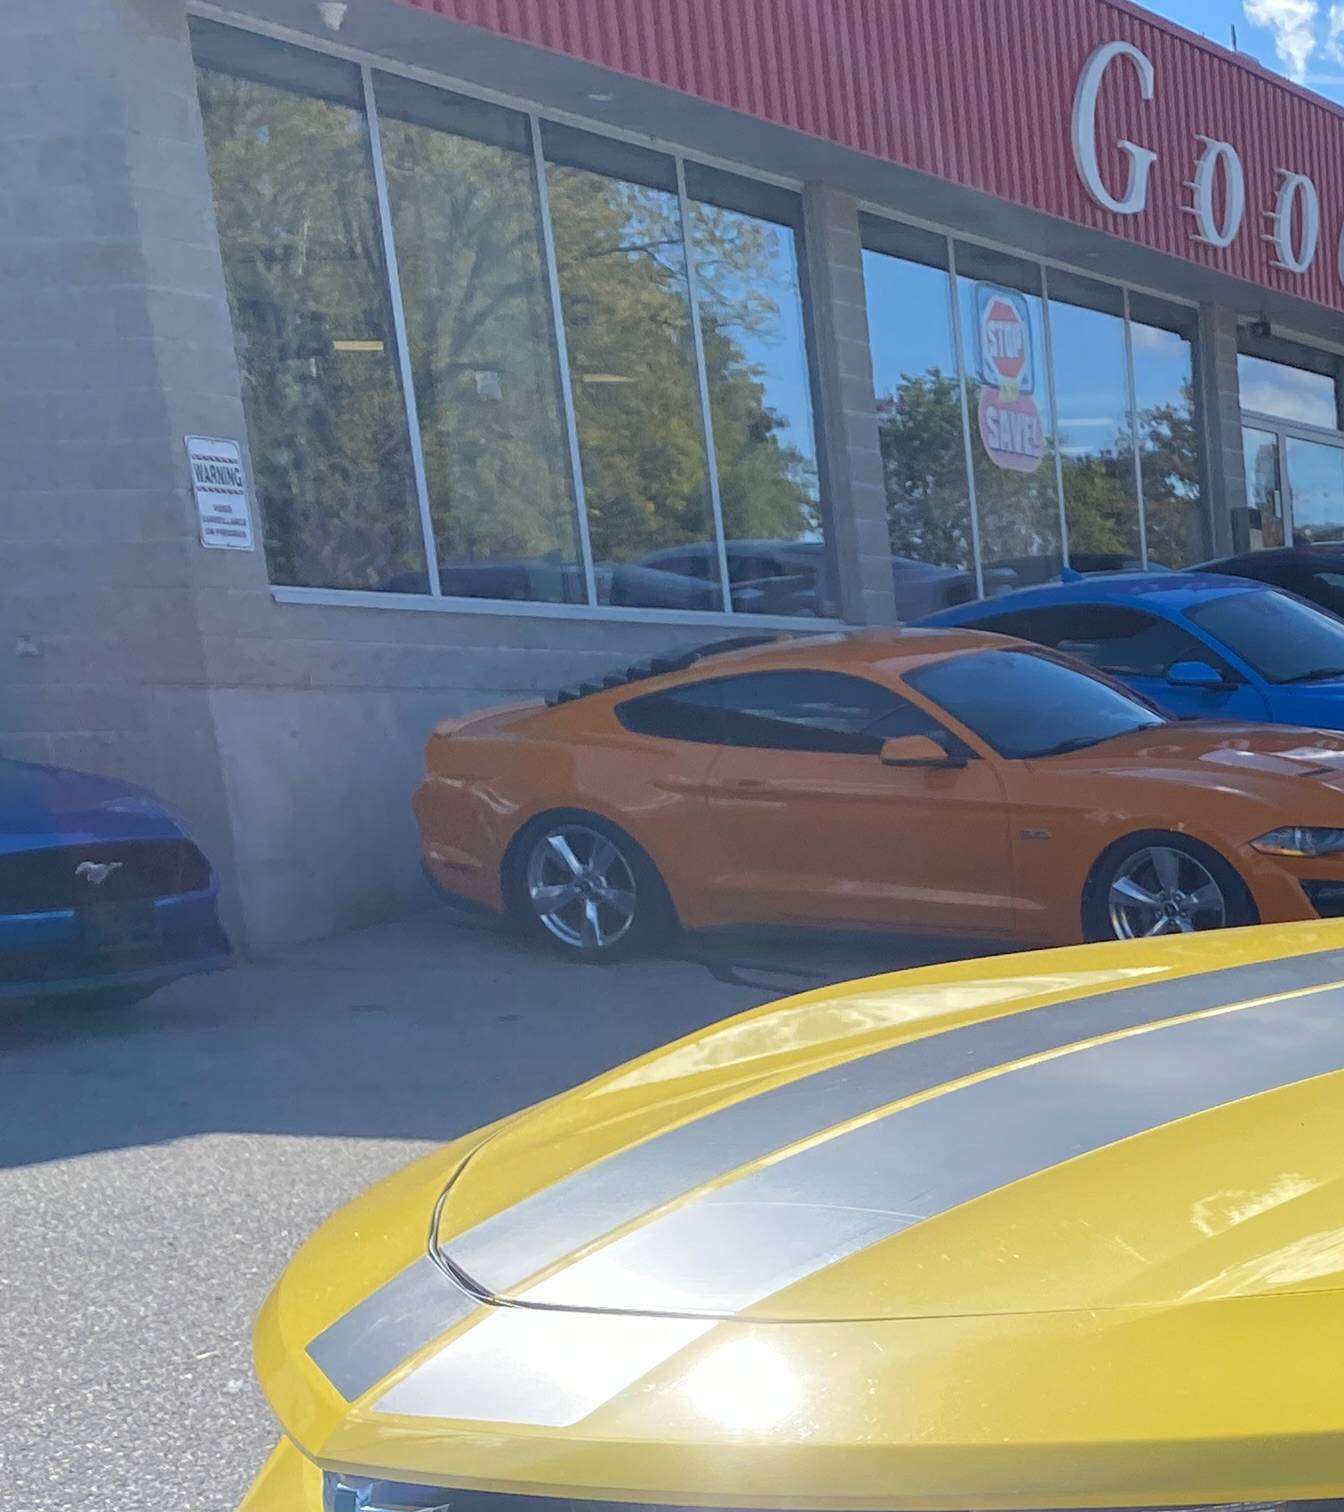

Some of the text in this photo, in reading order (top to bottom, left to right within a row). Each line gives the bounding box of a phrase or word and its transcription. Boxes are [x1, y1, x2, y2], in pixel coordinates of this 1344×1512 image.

[986, 320, 1024, 358] STOP
[985, 405, 1040, 458] SAVE!
[192, 462, 243, 487] WARNING
